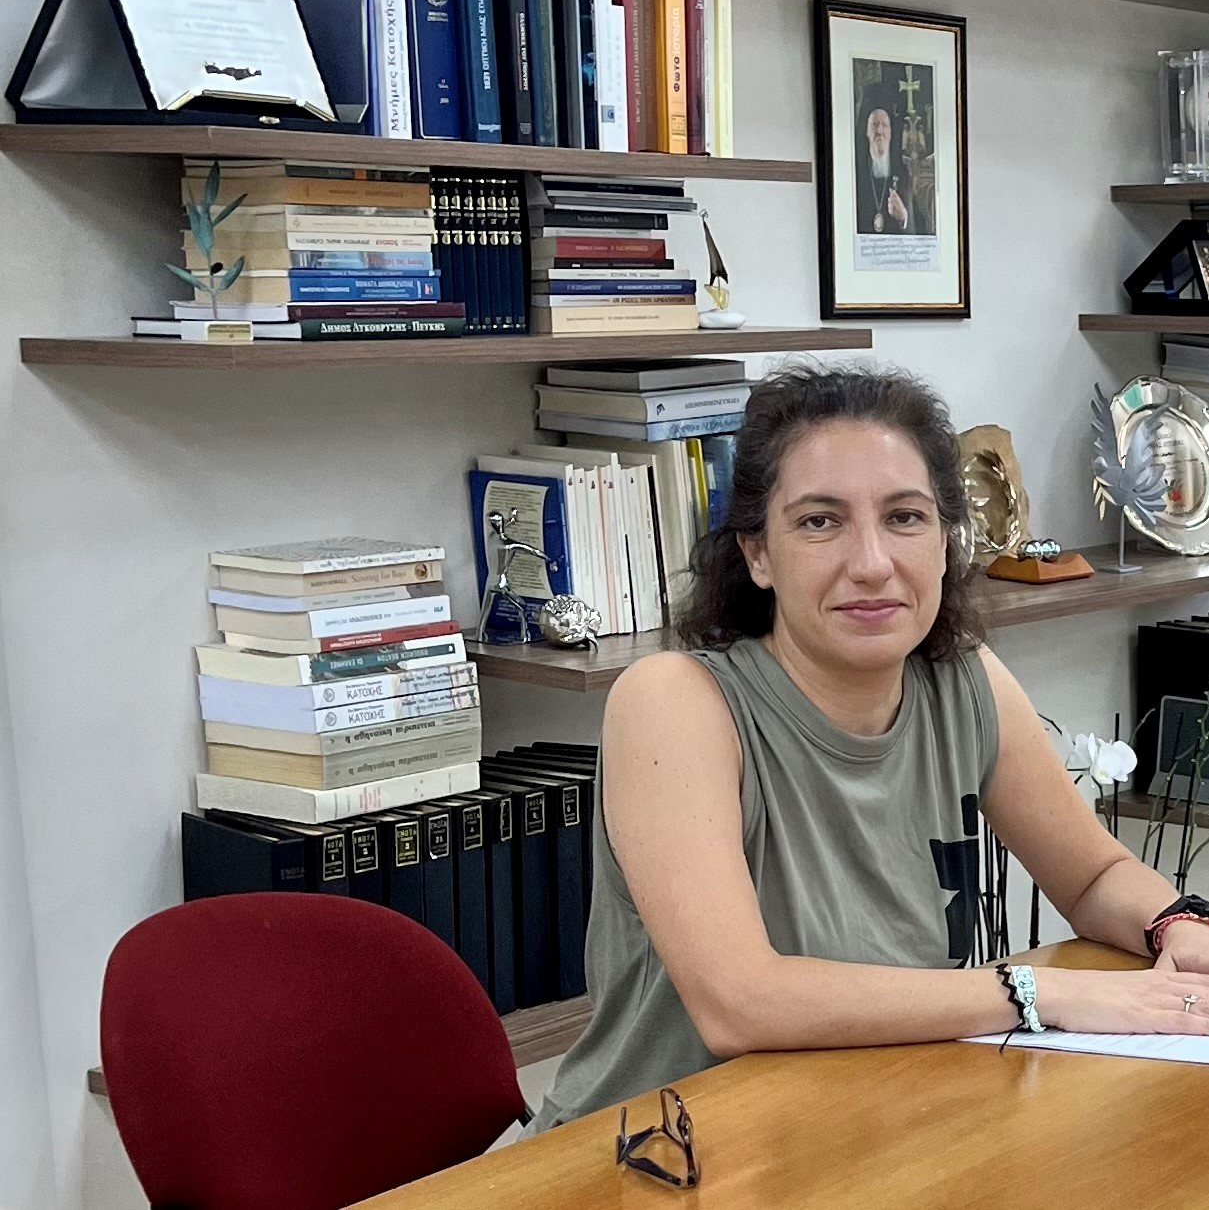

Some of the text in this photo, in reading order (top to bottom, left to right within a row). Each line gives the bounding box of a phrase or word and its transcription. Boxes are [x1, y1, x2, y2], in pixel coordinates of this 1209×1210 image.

[388, 71, 402, 132] Μνήμες
[320, 322, 351, 333] ΔΗΜΟΣ
[353, 322, 406, 332] ΛΥΚΟΒΡΥΣΗΣ
[412, 321, 446, 331] ΠΕΥΚΗΣ
[346, 685, 384, 700] ΚΑΤΟΧΗΣ
[348, 708, 386, 724] ΚΑΤΟΧΗΣ
